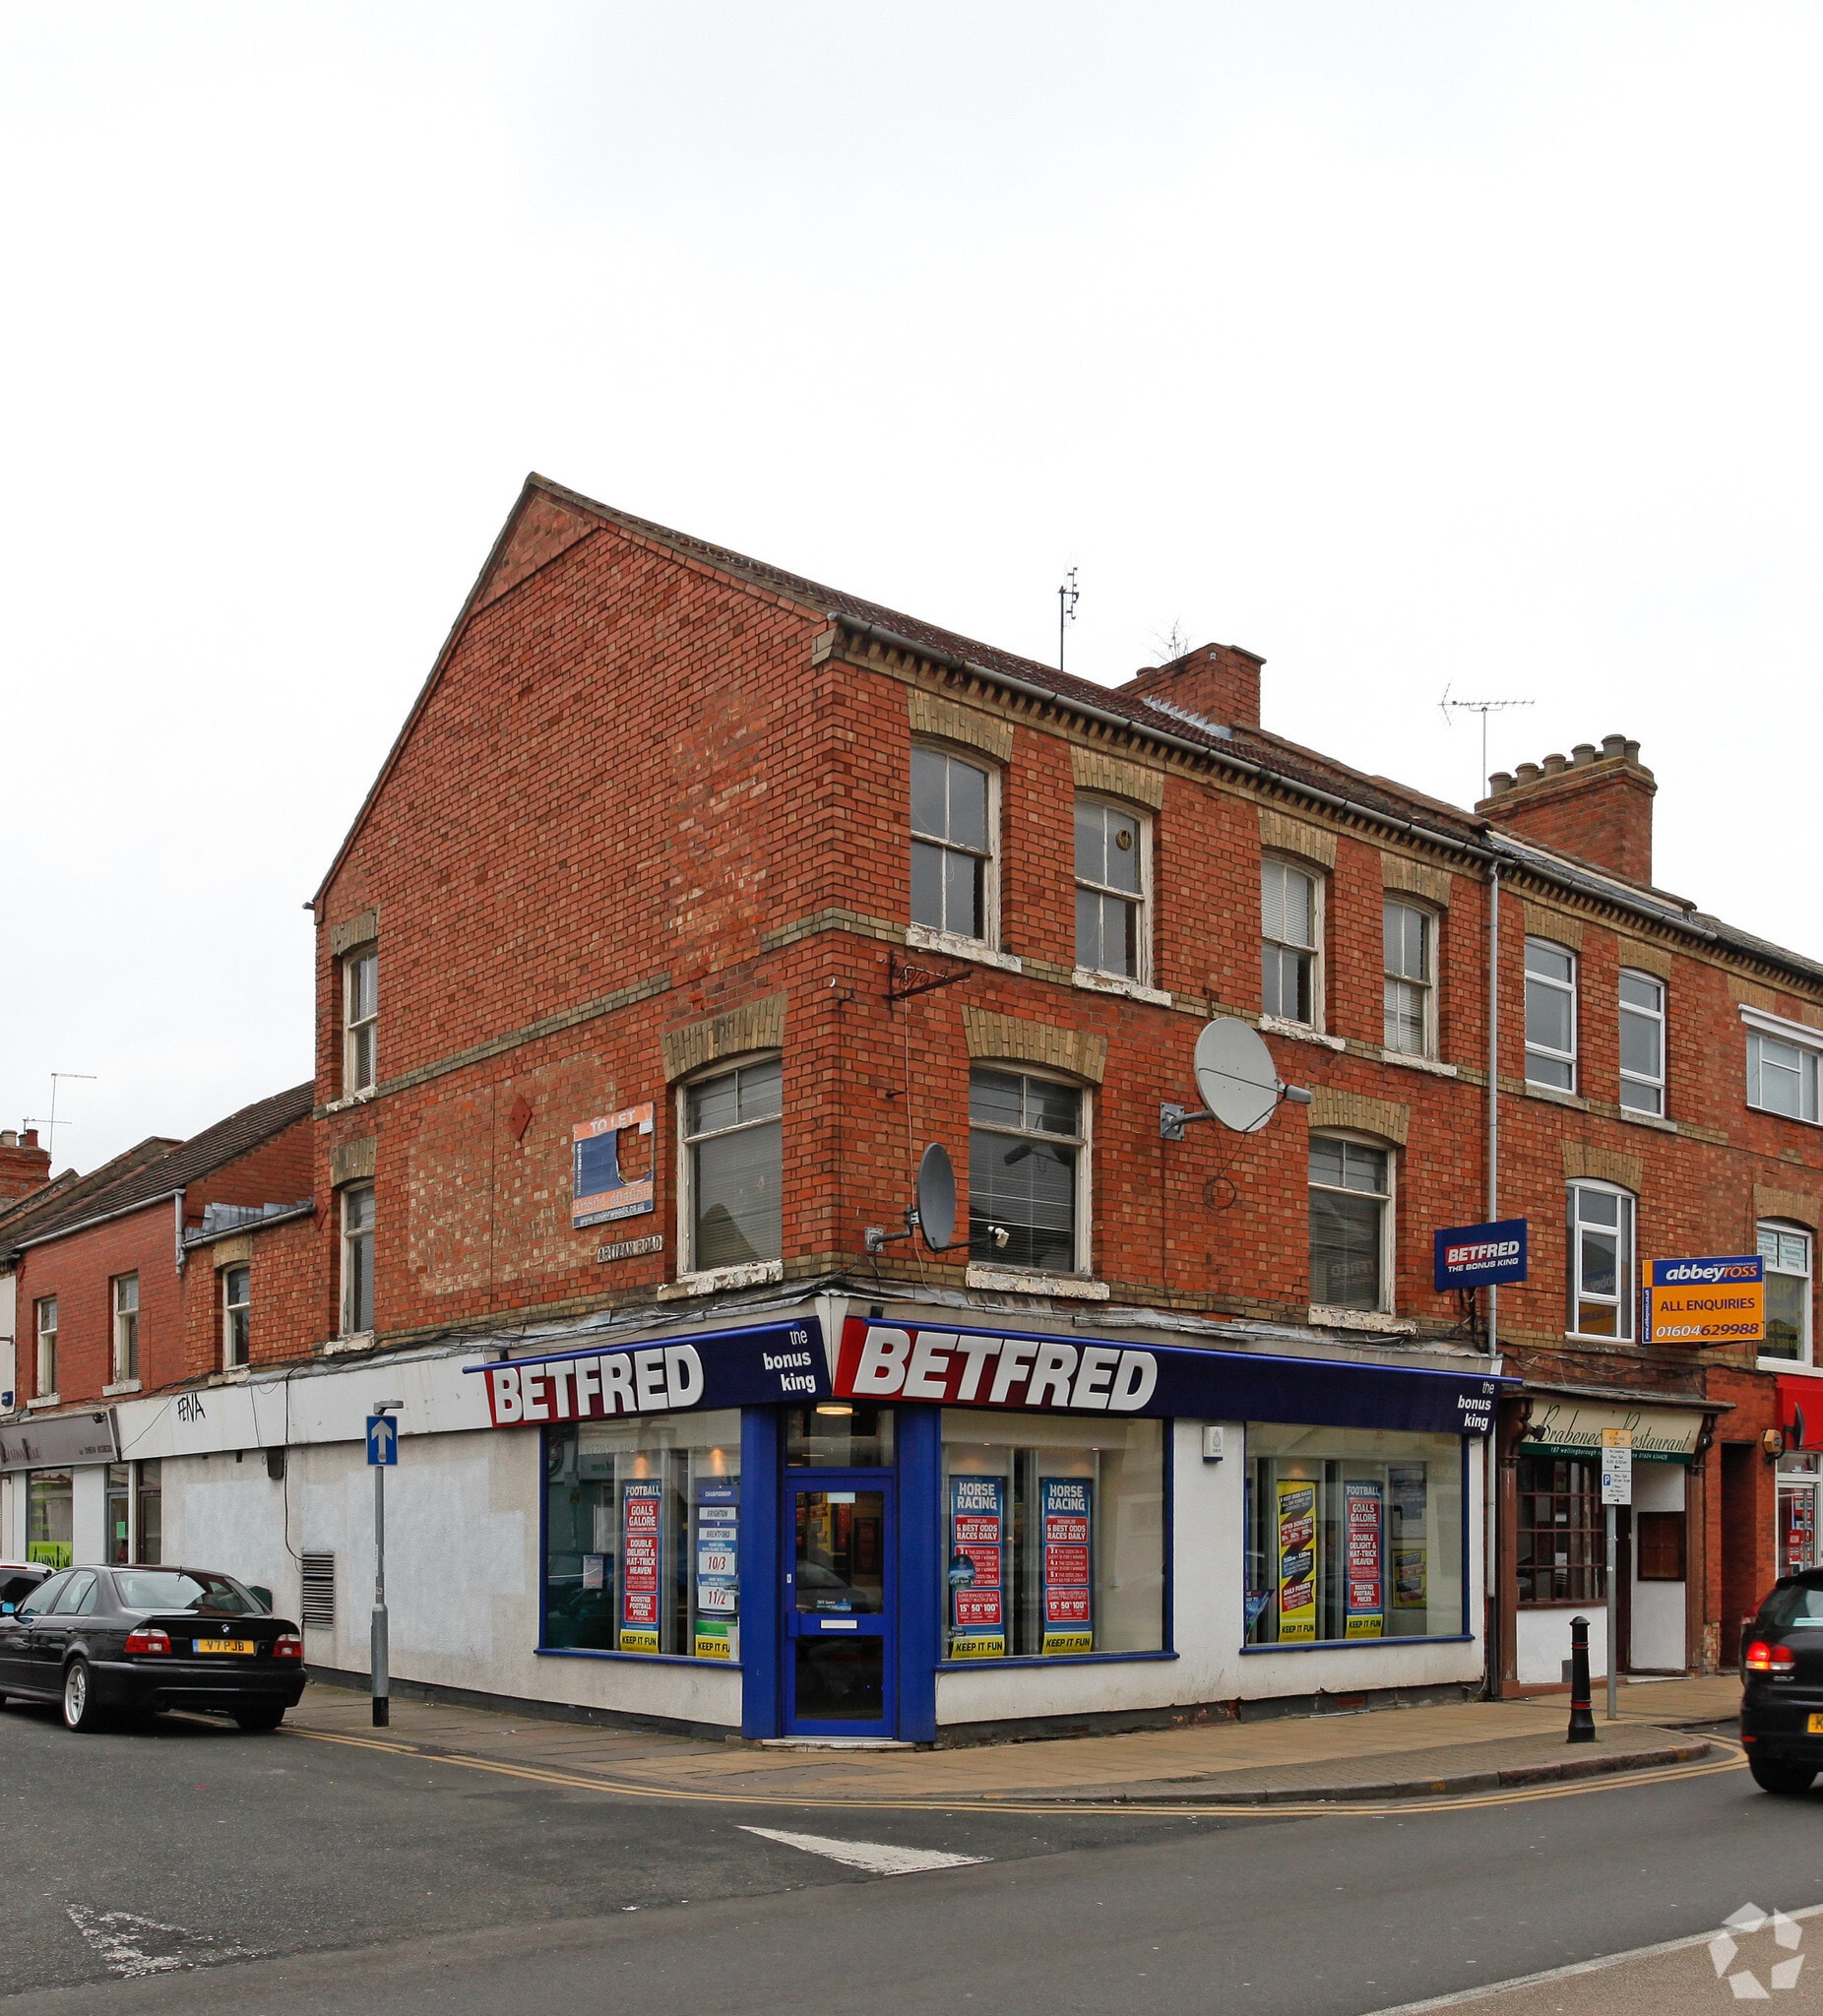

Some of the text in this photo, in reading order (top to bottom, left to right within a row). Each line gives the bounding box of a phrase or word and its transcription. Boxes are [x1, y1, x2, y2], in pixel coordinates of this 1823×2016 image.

[591, 1110, 635, 1134] TO LET
[598, 1236, 660, 1261] ARTIZAN ROAD
[1448, 1240, 1520, 1262] BETFRED
[1466, 1260, 1496, 1270] BONUS
[1497, 1258, 1518, 1267] KING
[1661, 1297, 1754, 1311] ALL ENQUIRIES
[789, 1330, 807, 1345] the
[763, 1352, 811, 1370] bonus
[852, 1326, 1158, 1412] BETFRED
[492, 1344, 705, 1423] BETFRED
[780, 1372, 817, 1393] king
[1482, 1380, 1494, 1394] the
[1457, 1394, 1492, 1410] bonus
[1464, 1414, 1488, 1431] king
[1604, 1476, 1609, 1484] P
[626, 1486, 660, 1496] FOOTBALL
[959, 1482, 995, 1496] HORSE
[1049, 1483, 1083, 1497] HORSE
[1347, 1486, 1380, 1495] FOOTBALL
[957, 1496, 997, 1510] RACING
[1047, 1497, 1085, 1511] RACING
[632, 1506, 654, 1516] GOALS
[629, 1517, 656, 1526] GALORE
[709, 1556, 725, 1570] 10/3
[207, 1640, 244, 1651] V7 PJB
[956, 1642, 1002, 1652] KEEP IT FUN
